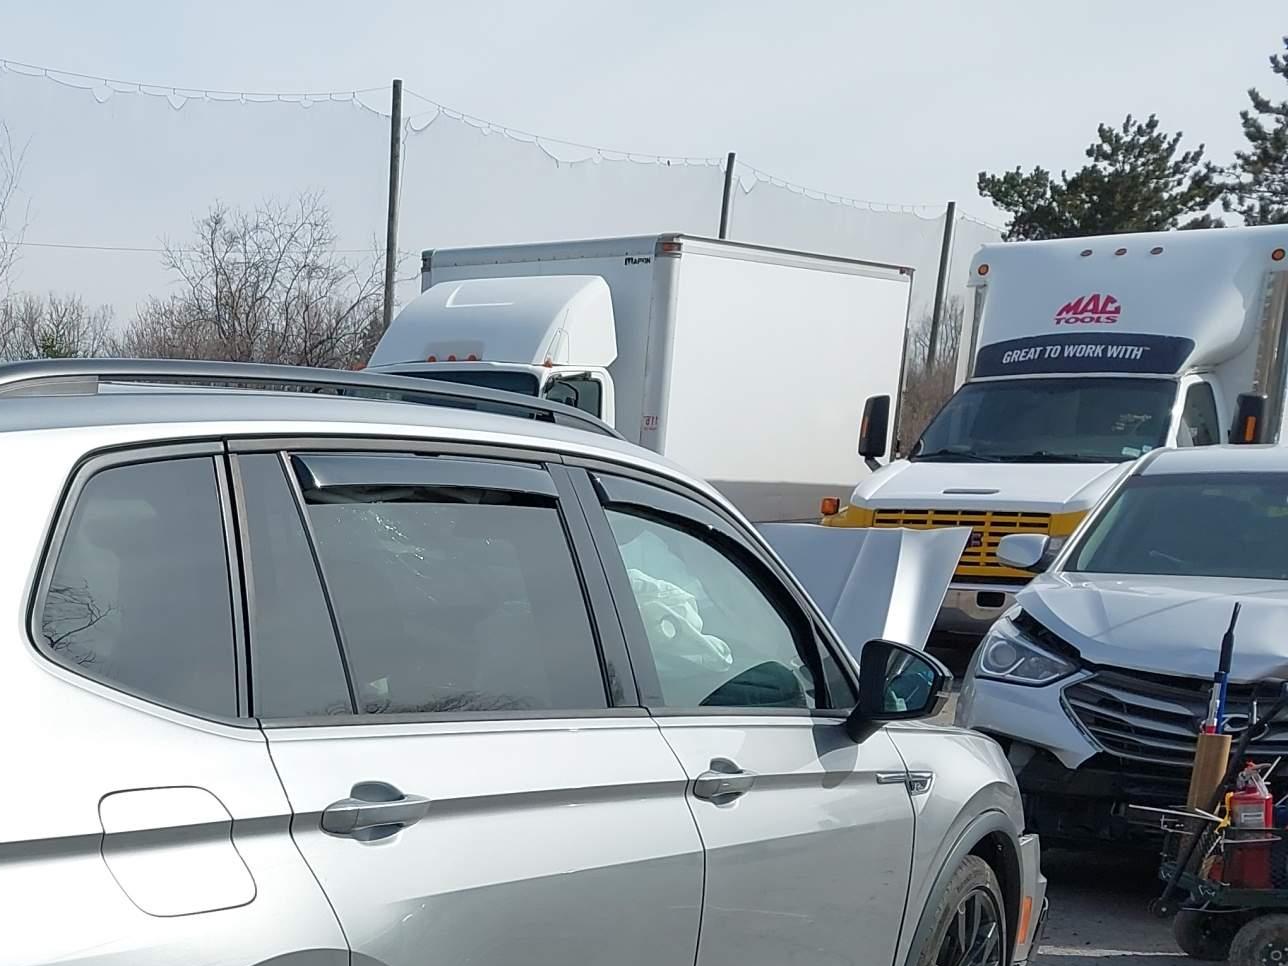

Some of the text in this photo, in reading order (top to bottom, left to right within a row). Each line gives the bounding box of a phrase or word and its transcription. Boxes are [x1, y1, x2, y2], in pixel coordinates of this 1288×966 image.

[1056, 293, 1121, 316] MAC
[1054, 315, 1119, 325] TOOLS
[1001, 346, 1043, 364] GREAT
[1044, 345, 1062, 359] TO
[1063, 344, 1105, 358] WORK
